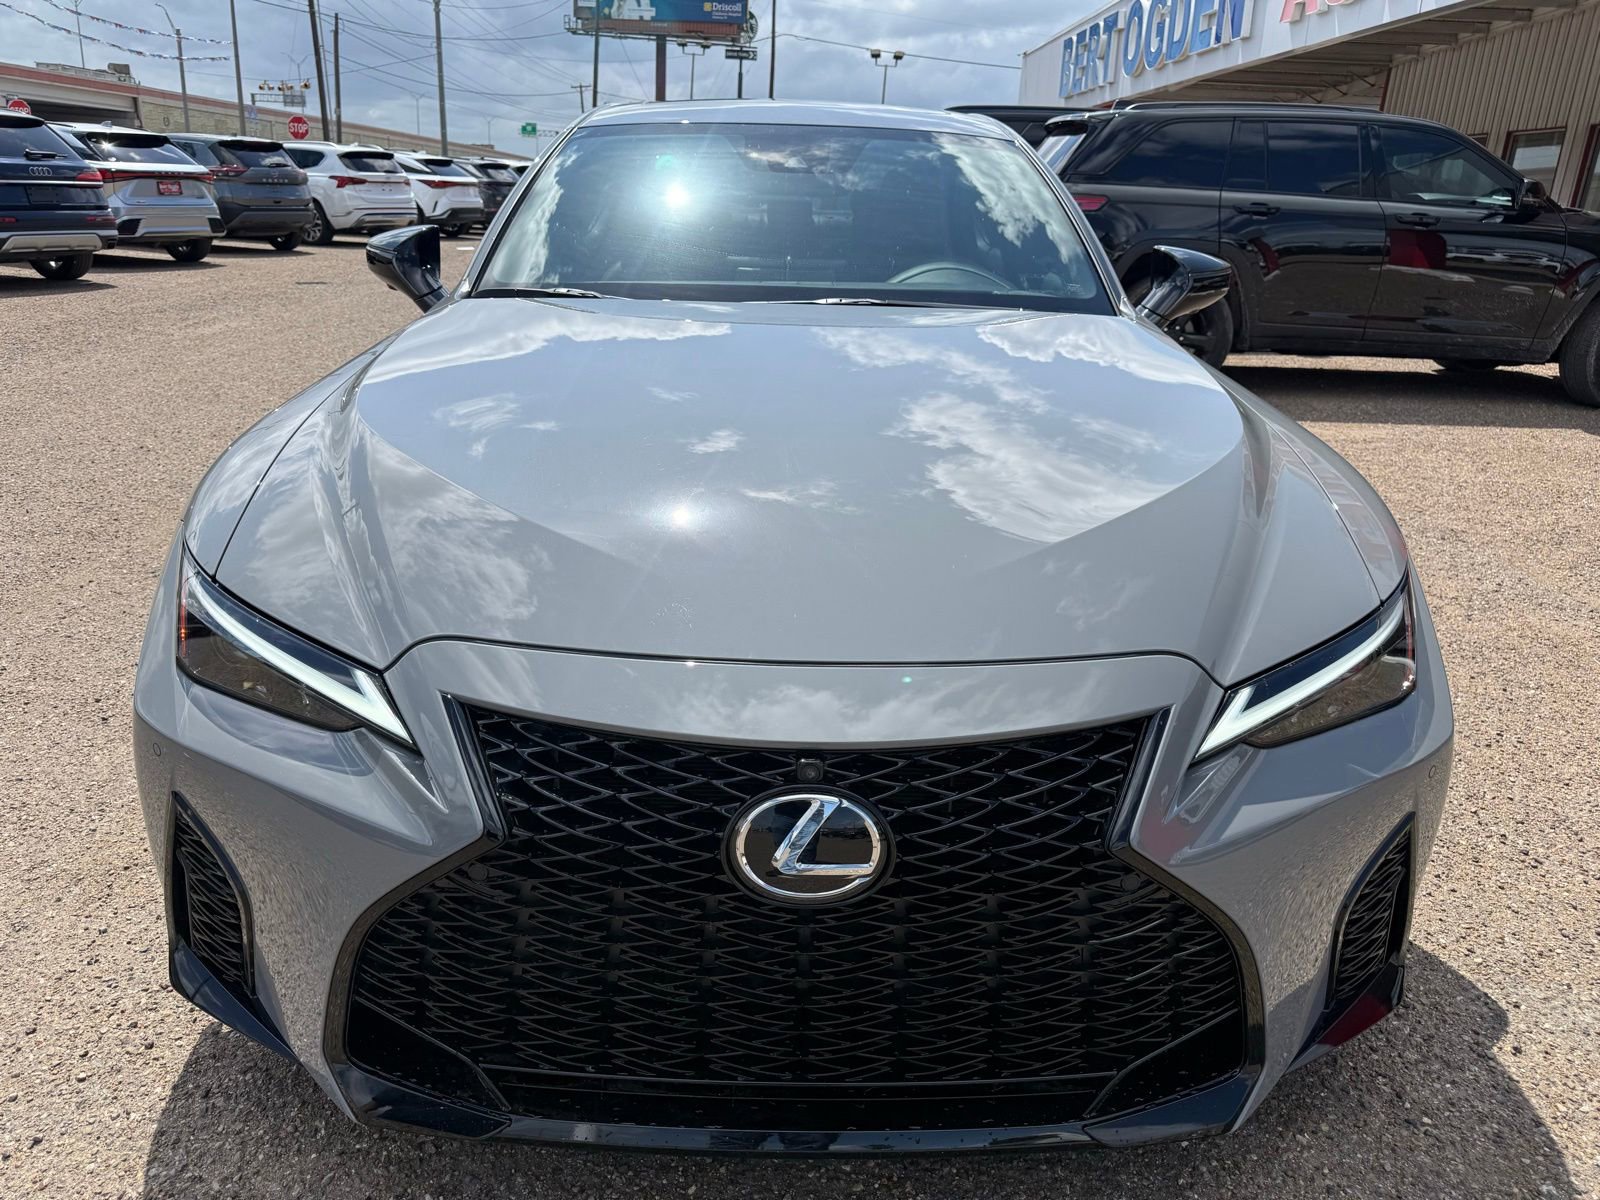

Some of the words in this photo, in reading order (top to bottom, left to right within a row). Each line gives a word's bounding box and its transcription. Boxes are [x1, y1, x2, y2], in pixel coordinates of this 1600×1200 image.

[712, 2, 742, 11] Driscoll
[1059, 9, 1127, 98] BERT
[1122, 0, 1255, 77] OGDEN
[289, 123, 309, 133] STOP
